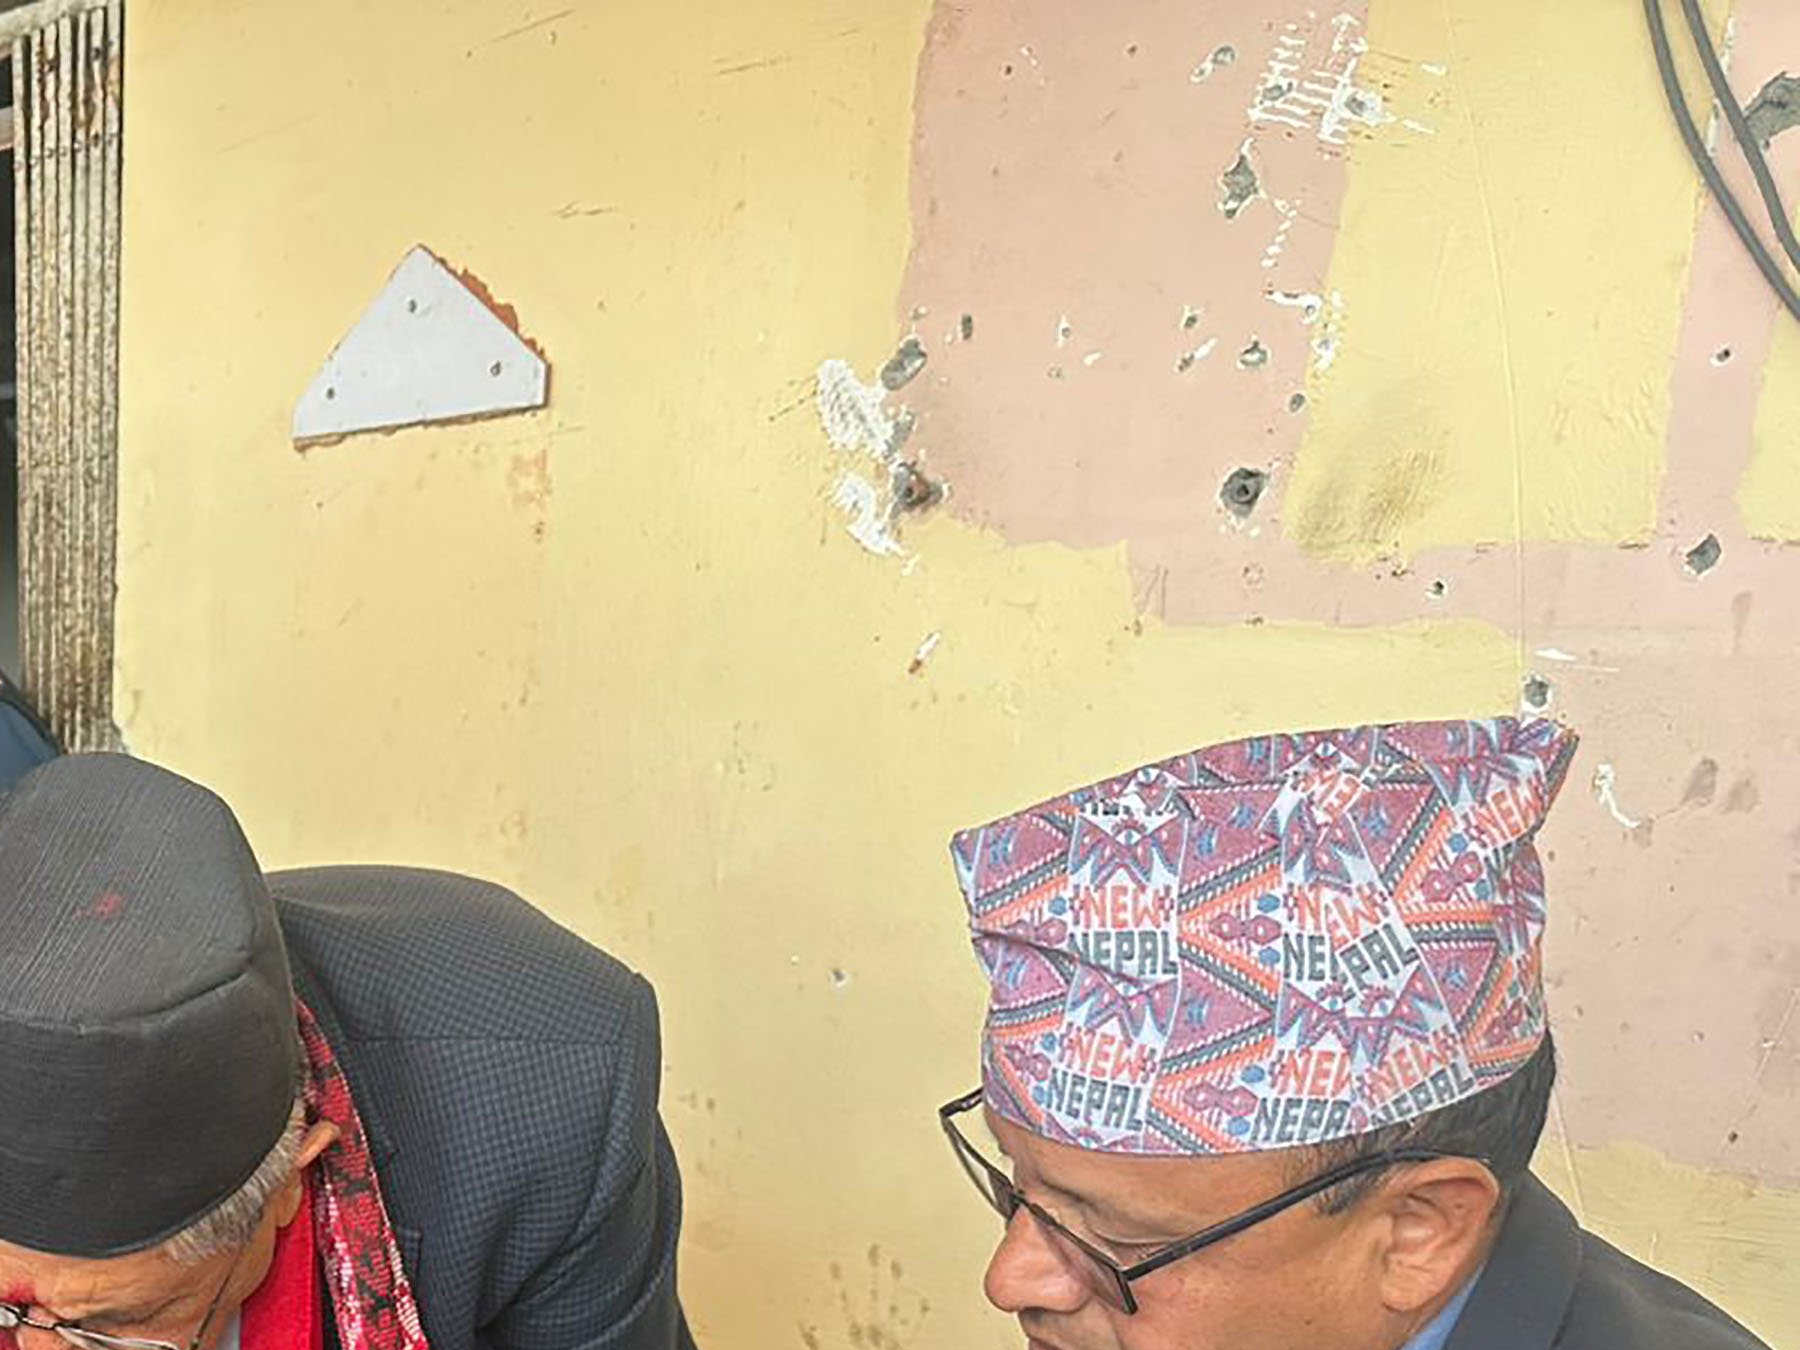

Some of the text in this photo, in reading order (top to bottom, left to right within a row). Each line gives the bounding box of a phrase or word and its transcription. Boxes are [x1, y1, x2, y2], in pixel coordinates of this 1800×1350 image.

[1084, 884, 1161, 929] NEW
[1067, 930, 1177, 975] NEPAL
[1067, 1026, 1147, 1084] NEW
[1365, 1033, 1451, 1107] NEW
[1045, 1067, 1142, 1131] NEPAL
